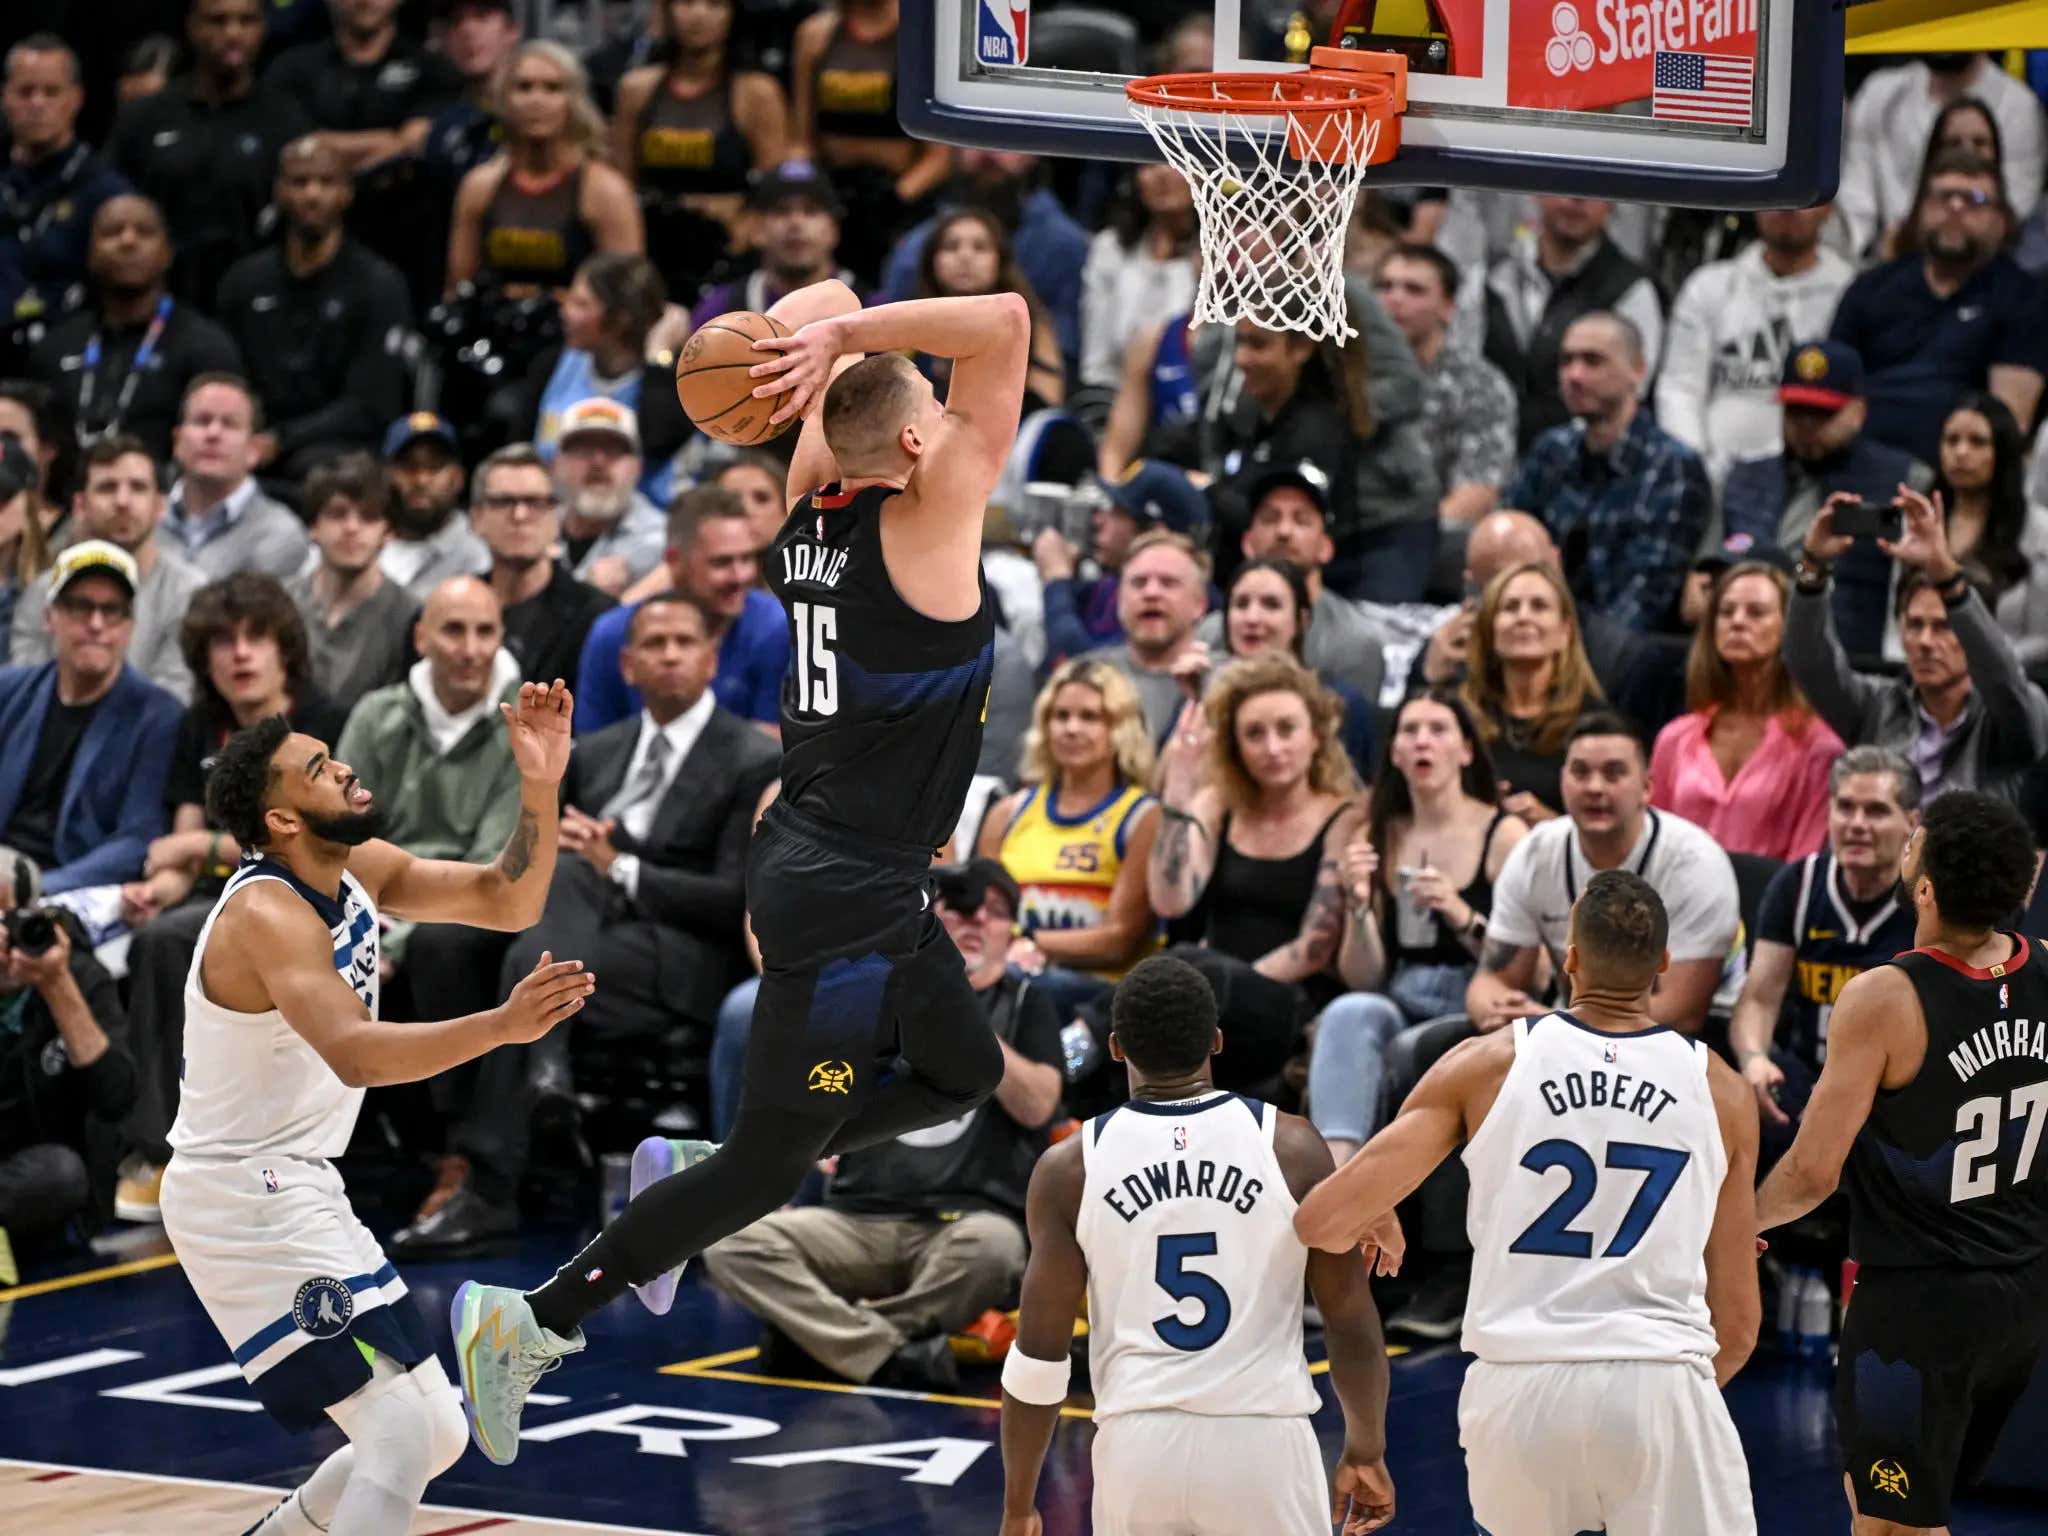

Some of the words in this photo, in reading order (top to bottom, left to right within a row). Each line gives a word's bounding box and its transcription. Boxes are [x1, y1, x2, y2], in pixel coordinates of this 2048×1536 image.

[983, 35, 1009, 59] NBA
[1596, 0, 1685, 64] State
[783, 543, 850, 588] JOKIĆ
[793, 601, 839, 717] 15
[1055, 841, 1101, 873] 55
[1947, 1018, 2048, 1083] MURRA
[1539, 1070, 1678, 1124] GOBERT
[1950, 1079, 2048, 1204] 27
[1103, 1159, 1264, 1224] EDWARDS
[1508, 1138, 1692, 1259] 27
[1152, 1231, 1232, 1352] 5
